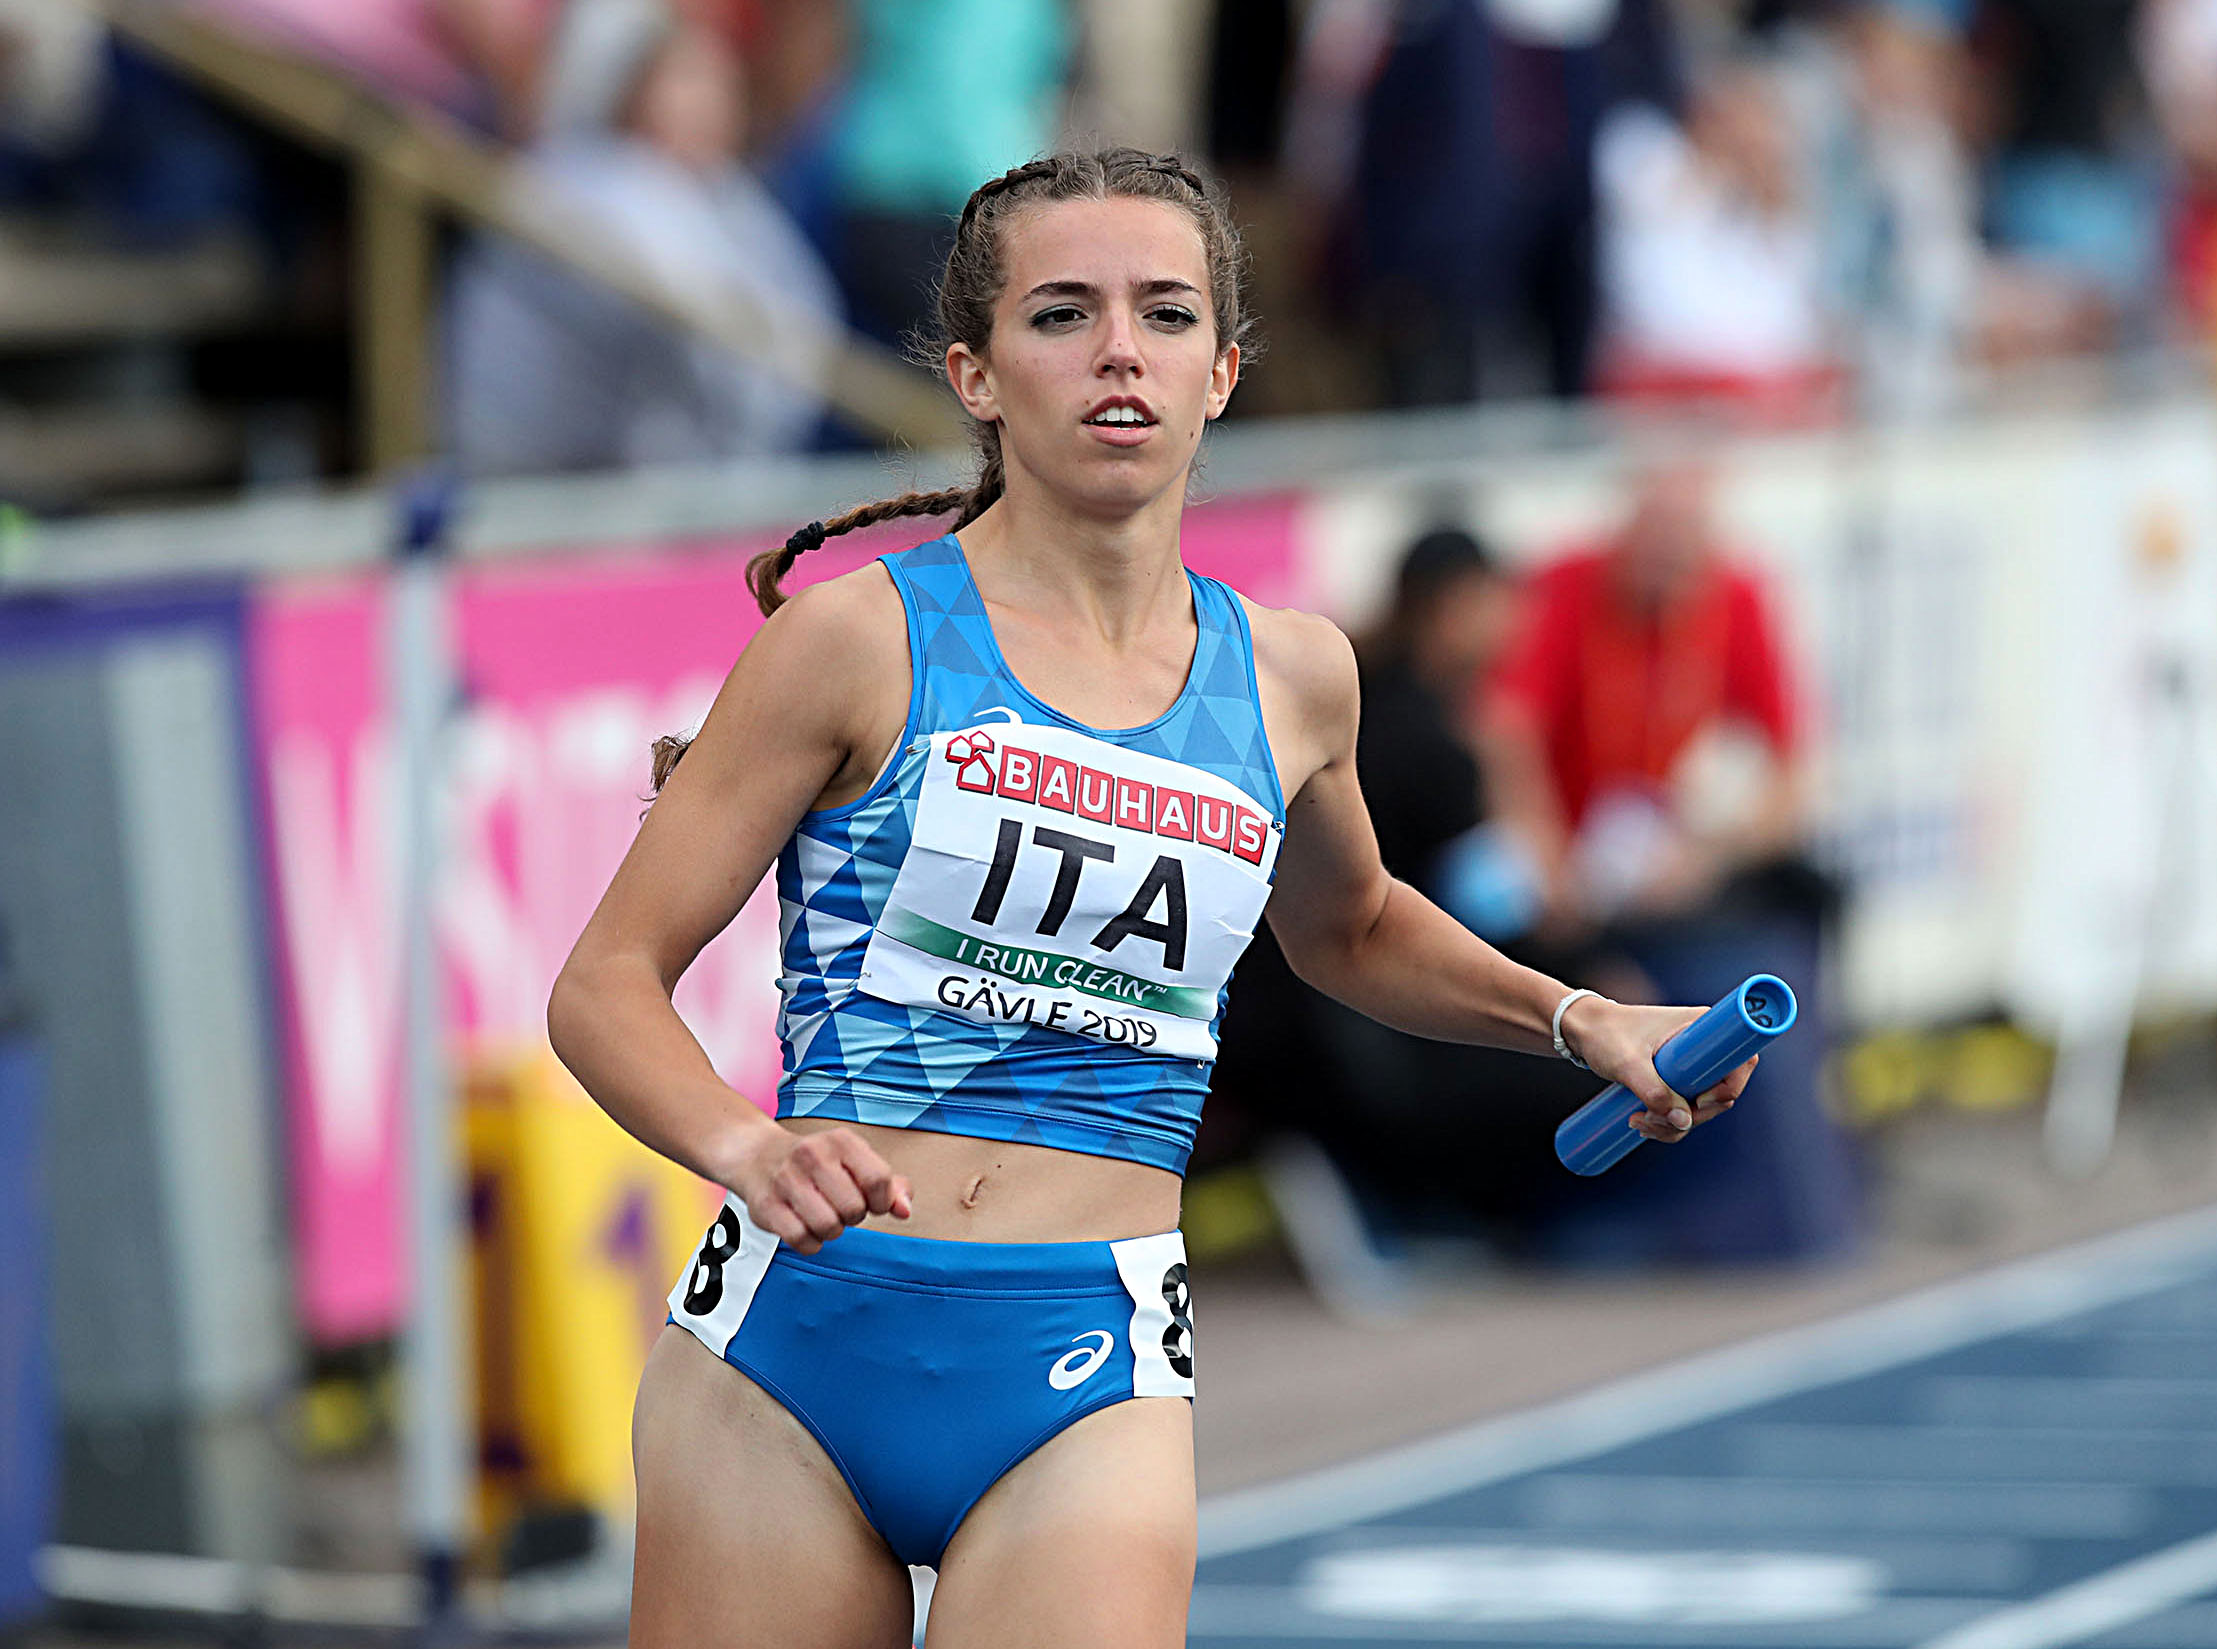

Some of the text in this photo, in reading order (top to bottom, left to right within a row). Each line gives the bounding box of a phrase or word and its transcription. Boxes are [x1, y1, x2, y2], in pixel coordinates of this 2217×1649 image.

[999, 751, 1265, 864] BAUHAUS
[971, 818, 1188, 971] ITA
[937, 975, 1158, 1048] GÄVLE 2019
[955, 938, 969, 959] I
[974, 943, 1049, 981] RUN
[683, 1203, 741, 1316] 8
